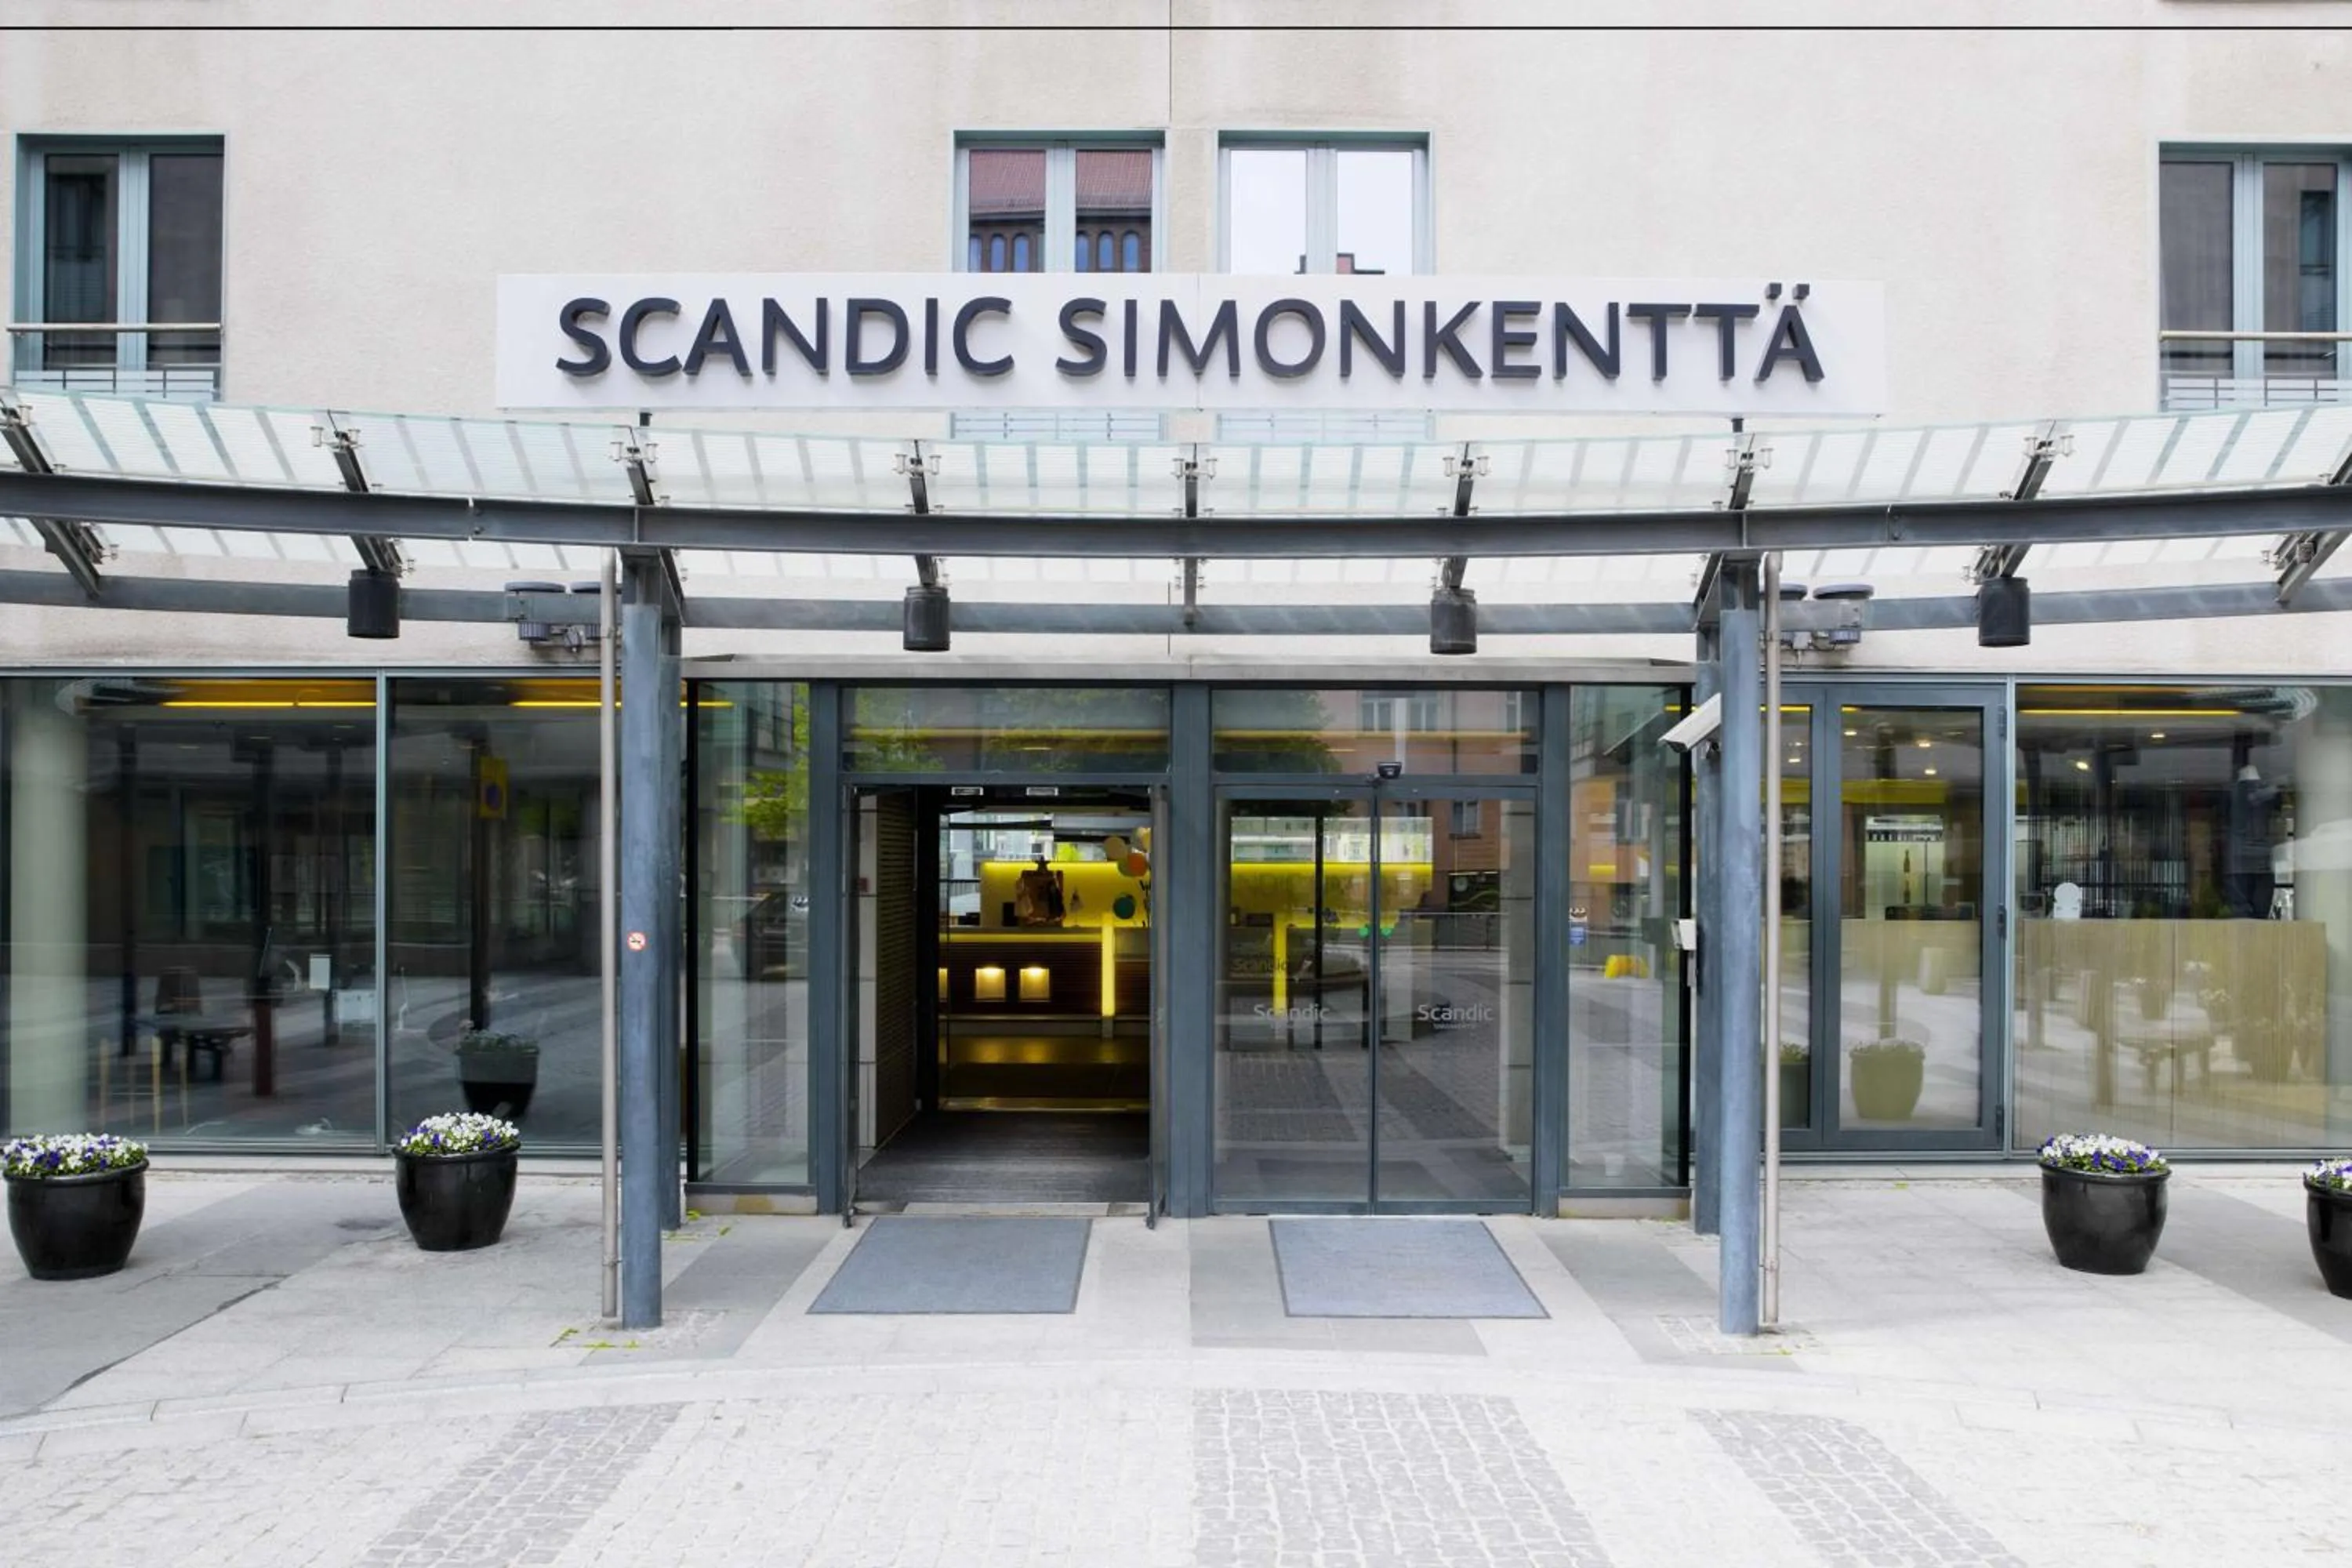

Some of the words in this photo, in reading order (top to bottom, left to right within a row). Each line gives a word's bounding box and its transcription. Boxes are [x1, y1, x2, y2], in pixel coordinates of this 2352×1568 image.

[556, 296, 1014, 380] SCANDIC
[1055, 283, 1824, 383] SIMONKENTTÄ
[1253, 1003, 1330, 1021] Scandic
[1416, 1003, 1494, 1022] Scandic
